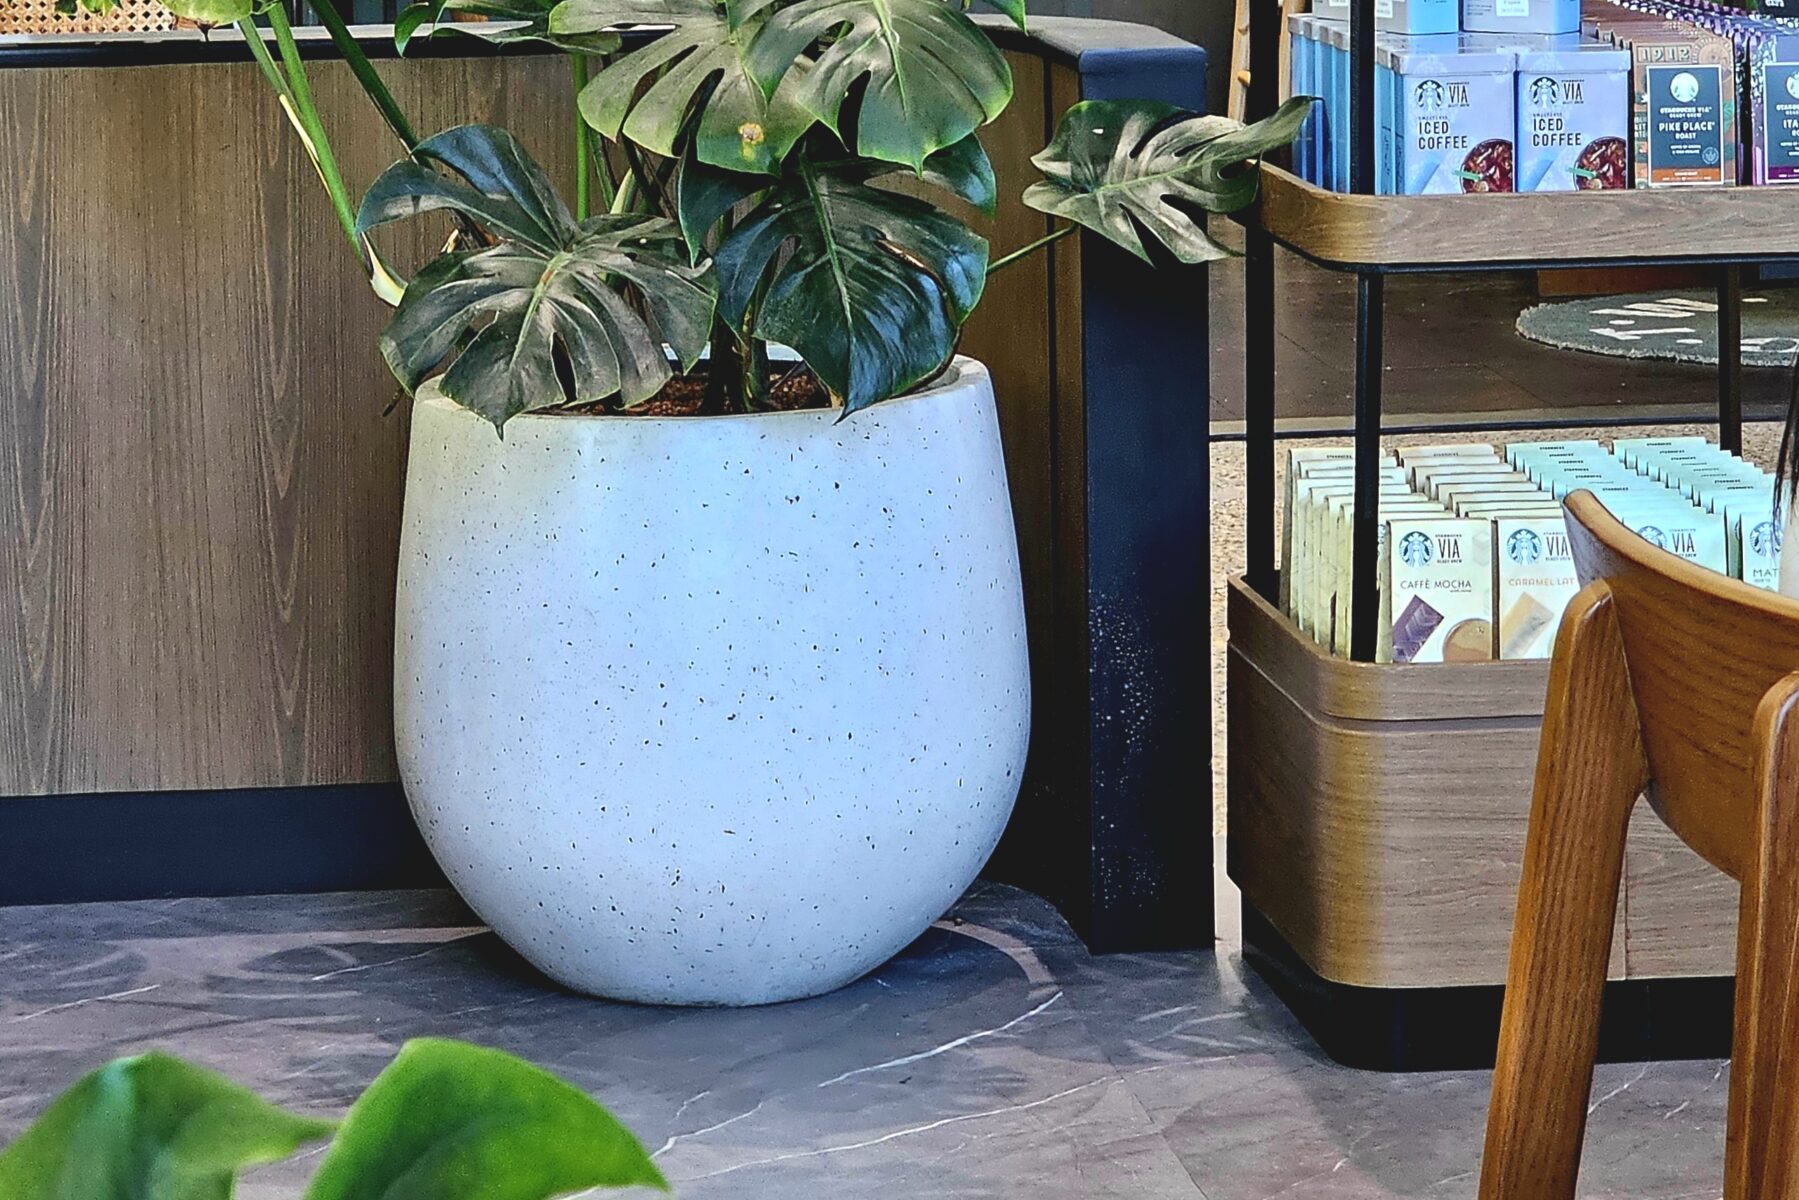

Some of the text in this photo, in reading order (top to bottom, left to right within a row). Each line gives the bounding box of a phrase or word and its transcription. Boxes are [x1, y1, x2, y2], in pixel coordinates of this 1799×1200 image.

[1640, 46, 1691, 62] 1912
[1448, 85, 1468, 104] VIA
[1563, 82, 1583, 101] VIA
[1418, 121, 1449, 135] ICED
[1533, 118, 1563, 132] ICED
[1659, 121, 1713, 132] PIKE PLACE
[1418, 135, 1469, 150] COFFEE
[1533, 132, 1582, 147] COFFEE
[1438, 538, 1460, 559] VIA
[1546, 536, 1569, 556] VIA
[1672, 532, 1695, 553] VIA
[1753, 568, 1779, 578] MAT
[1400, 578, 1472, 589] CAFFÈ MOCHA
[1508, 577, 1576, 586] CARAMEL LAT
